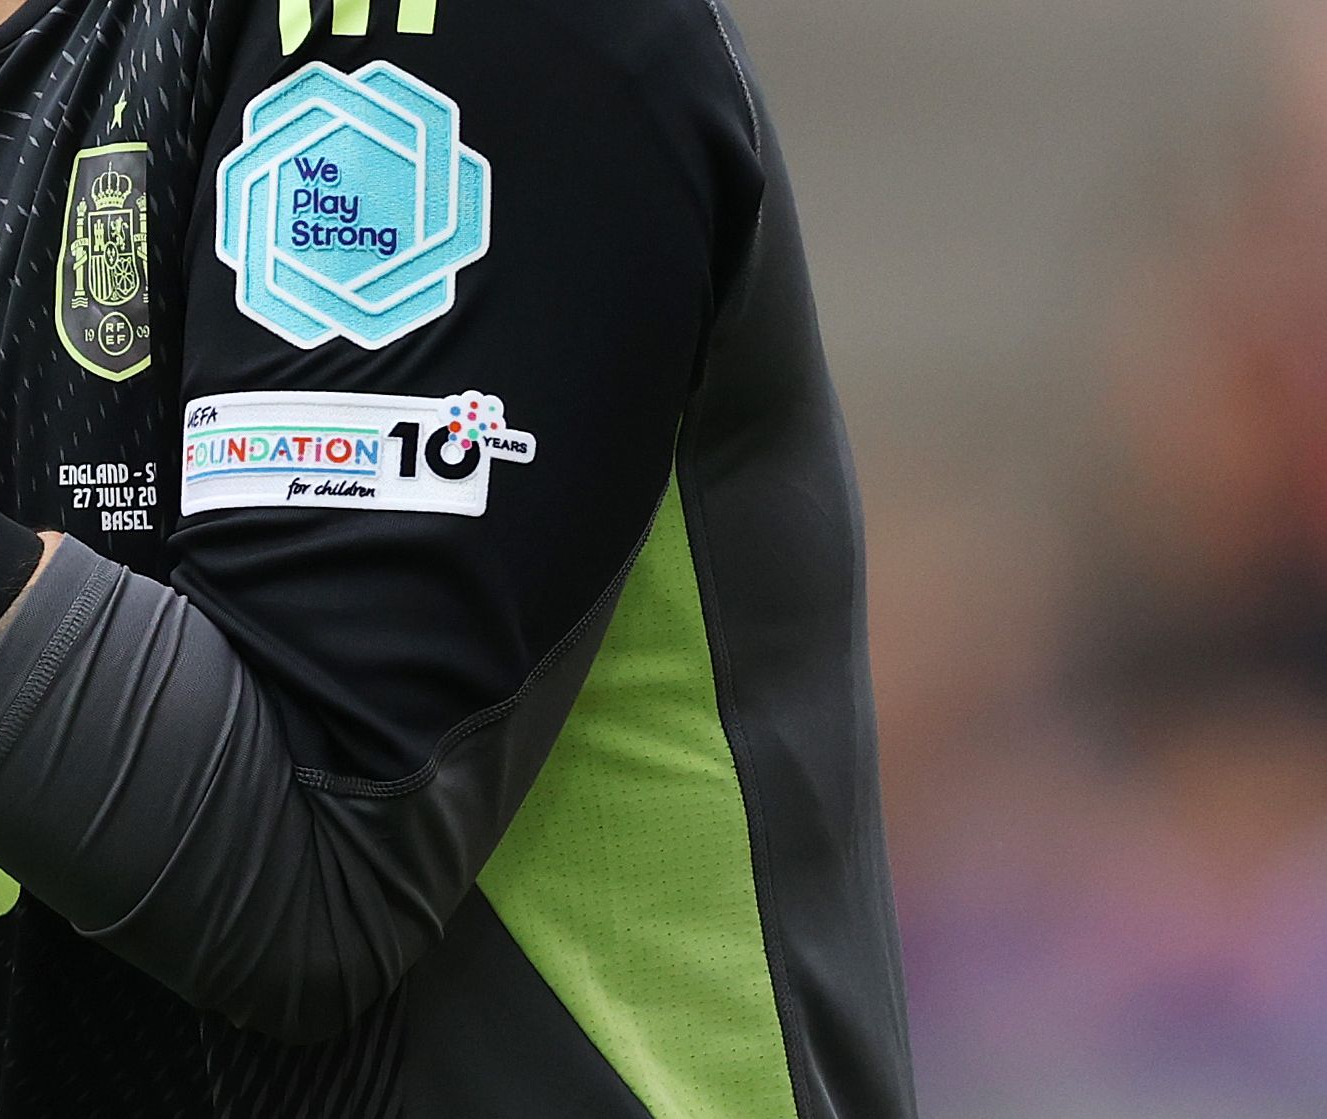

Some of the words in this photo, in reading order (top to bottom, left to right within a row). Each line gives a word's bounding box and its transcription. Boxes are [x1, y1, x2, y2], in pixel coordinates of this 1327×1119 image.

[294, 156, 339, 183] We
[292, 188, 359, 223] Play
[291, 220, 398, 256] Strong
[84, 328, 95, 342] 19
[387, 422, 482, 481] 10
[482, 435, 529, 454] YEARS
[58, 463, 129, 486] ENGLAND
[72, 487, 92, 509] 27
[95, 486, 135, 508] JULY
[286, 477, 312, 500] for
[313, 479, 376, 498] children
[101, 509, 154, 532] BASEL
